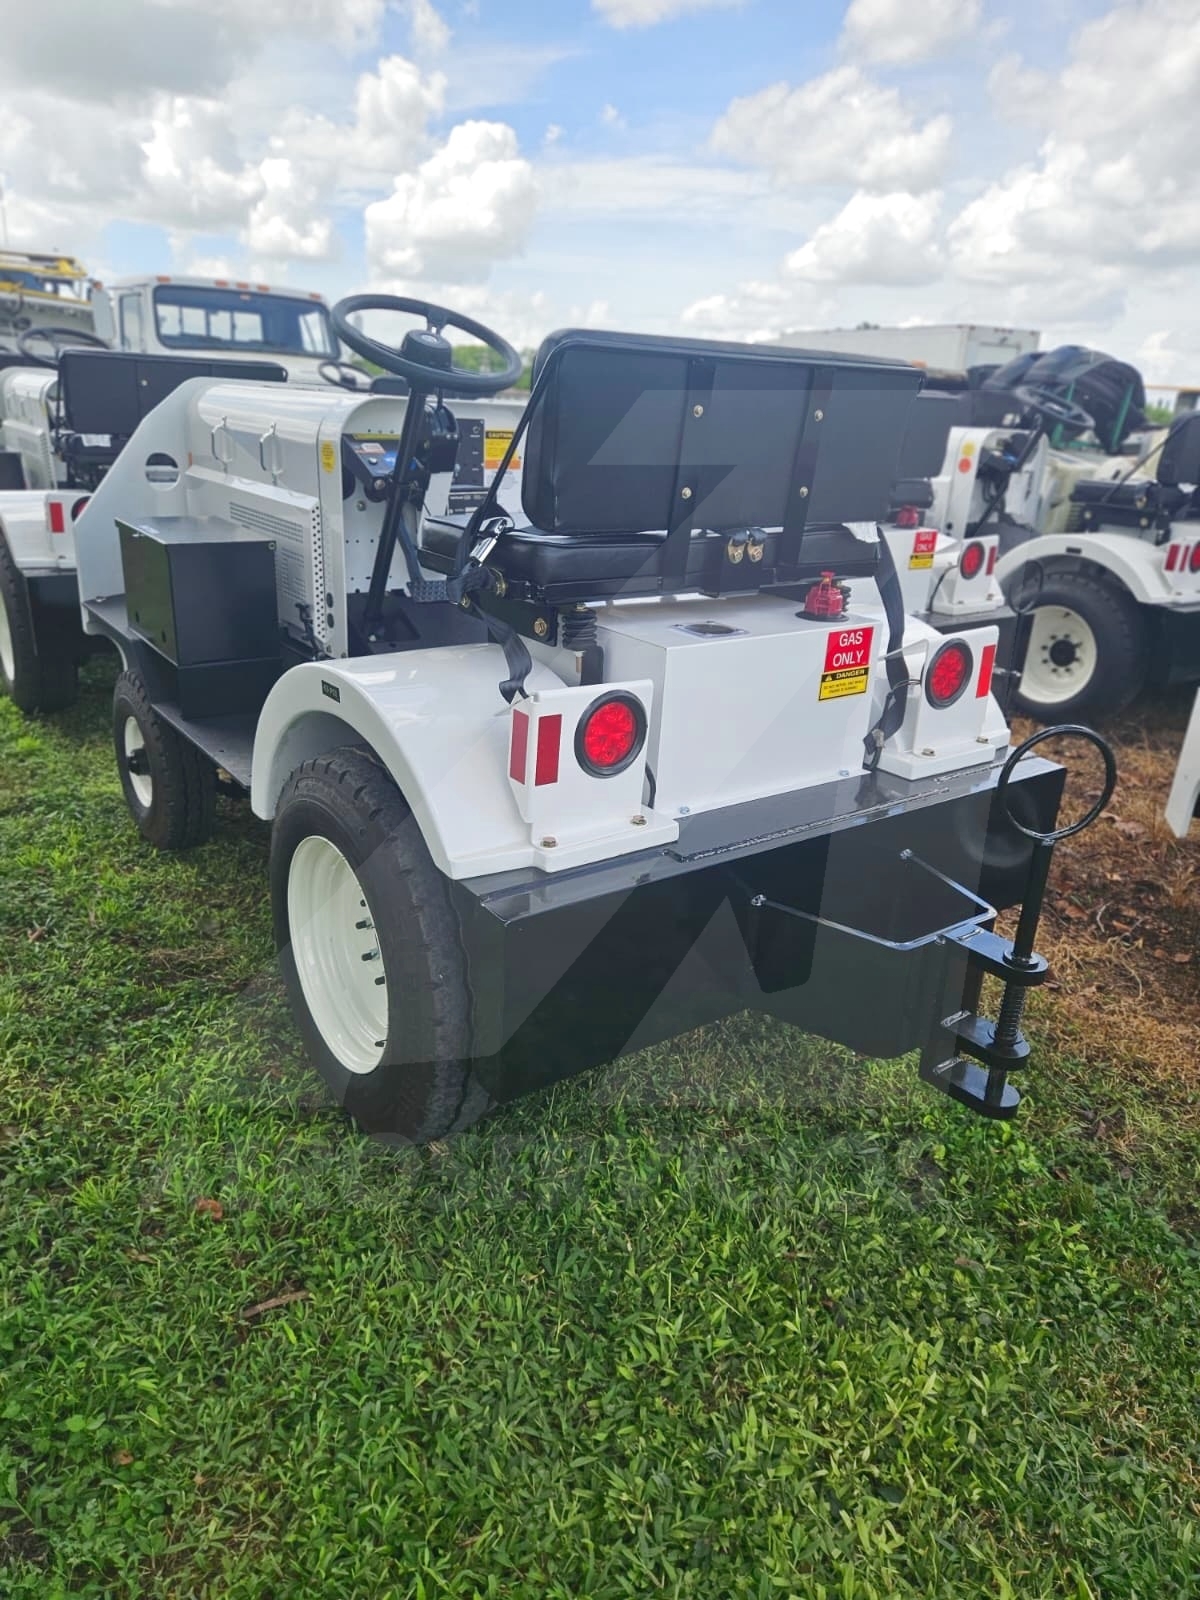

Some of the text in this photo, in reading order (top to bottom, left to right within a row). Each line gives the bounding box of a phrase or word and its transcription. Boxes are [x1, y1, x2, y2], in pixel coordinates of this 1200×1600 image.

[839, 632, 863, 647] GAS
[833, 650, 864, 667] ONLY
[836, 669, 865, 679] DANGER
